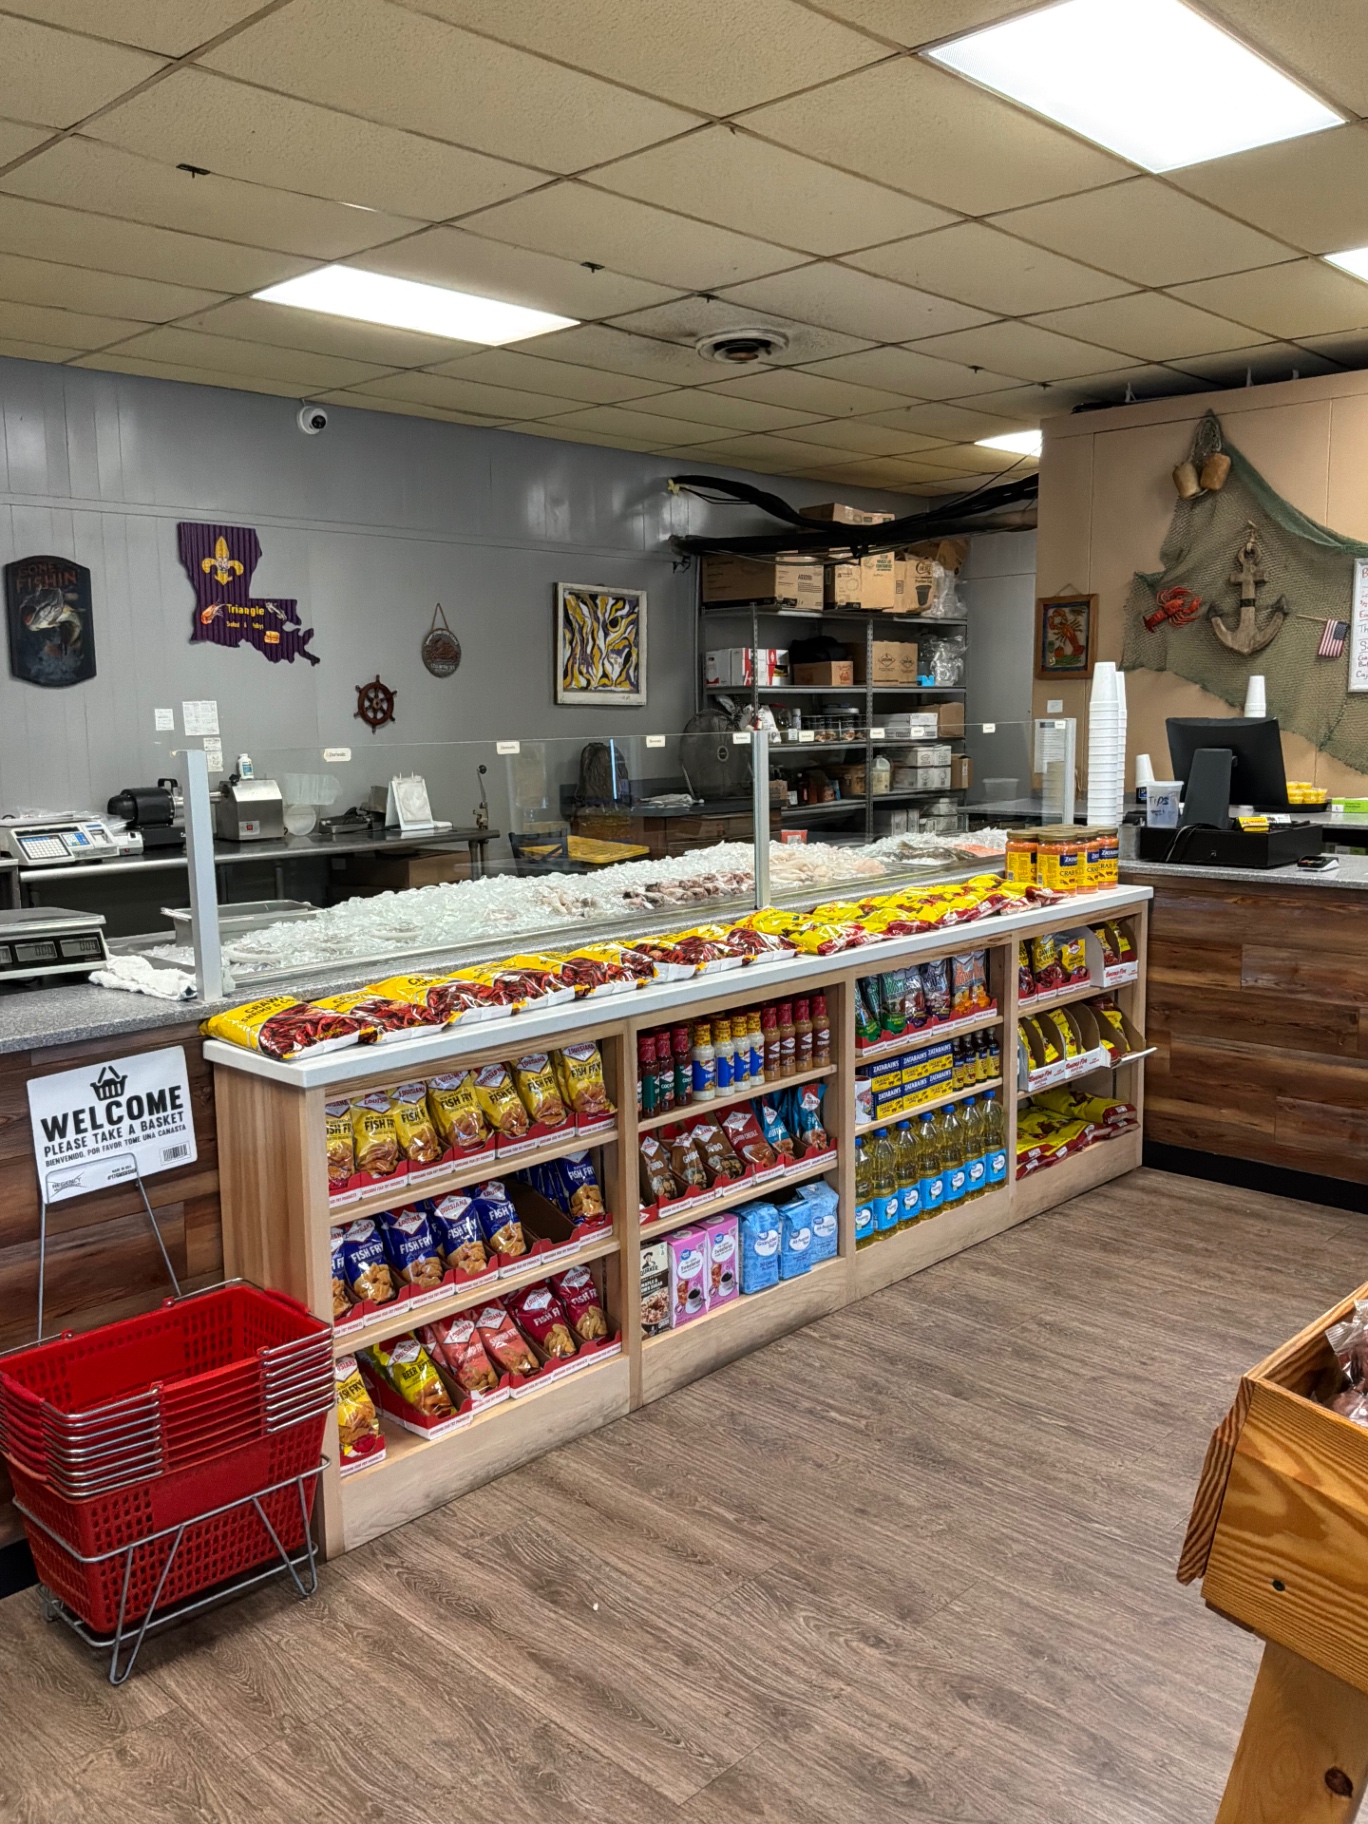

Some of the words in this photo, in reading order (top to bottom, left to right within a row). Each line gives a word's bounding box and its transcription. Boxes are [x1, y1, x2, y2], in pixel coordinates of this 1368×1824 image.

[16, 571, 77, 593] FISHIN
[226, 604, 264, 617] Triangle
[568, 1043, 595, 1054] LOUISIANA
[571, 1068, 587, 1078] FISH
[440, 1096, 460, 1110] FISH
[462, 1092, 474, 1102] FRY
[489, 1092, 506, 1104] FISH
[40, 1085, 184, 1142] WELCOME
[401, 1108, 420, 1123] FISH
[364, 1119, 385, 1130] FISH
[387, 1118, 395, 1128] FR
[44, 1136, 88, 1158] PLEASE
[92, 1126, 122, 1144] TAKE
[129, 1124, 136, 1135] A
[140, 1111, 184, 1132] BASKET
[88, 1146, 100, 1156] POR
[102, 1142, 122, 1152] FAVOR
[124, 1137, 141, 1146] TOME
[143, 1133, 156, 1141] UNA
[158, 1124, 186, 1136] CANASTA
[569, 1170, 584, 1180] FISH
[489, 1206, 509, 1220] FISH
[448, 1226, 462, 1240] FISH
[400, 1240, 419, 1254] FISH
[419, 1234, 433, 1247] FRY
[350, 1248, 370, 1262] FISH
[369, 1242, 383, 1256] FRY
[571, 1292, 590, 1305] FISH
[533, 1313, 552, 1326] FISH
[402, 1367, 418, 1380] BEER
[350, 1380, 364, 1394] FRY
